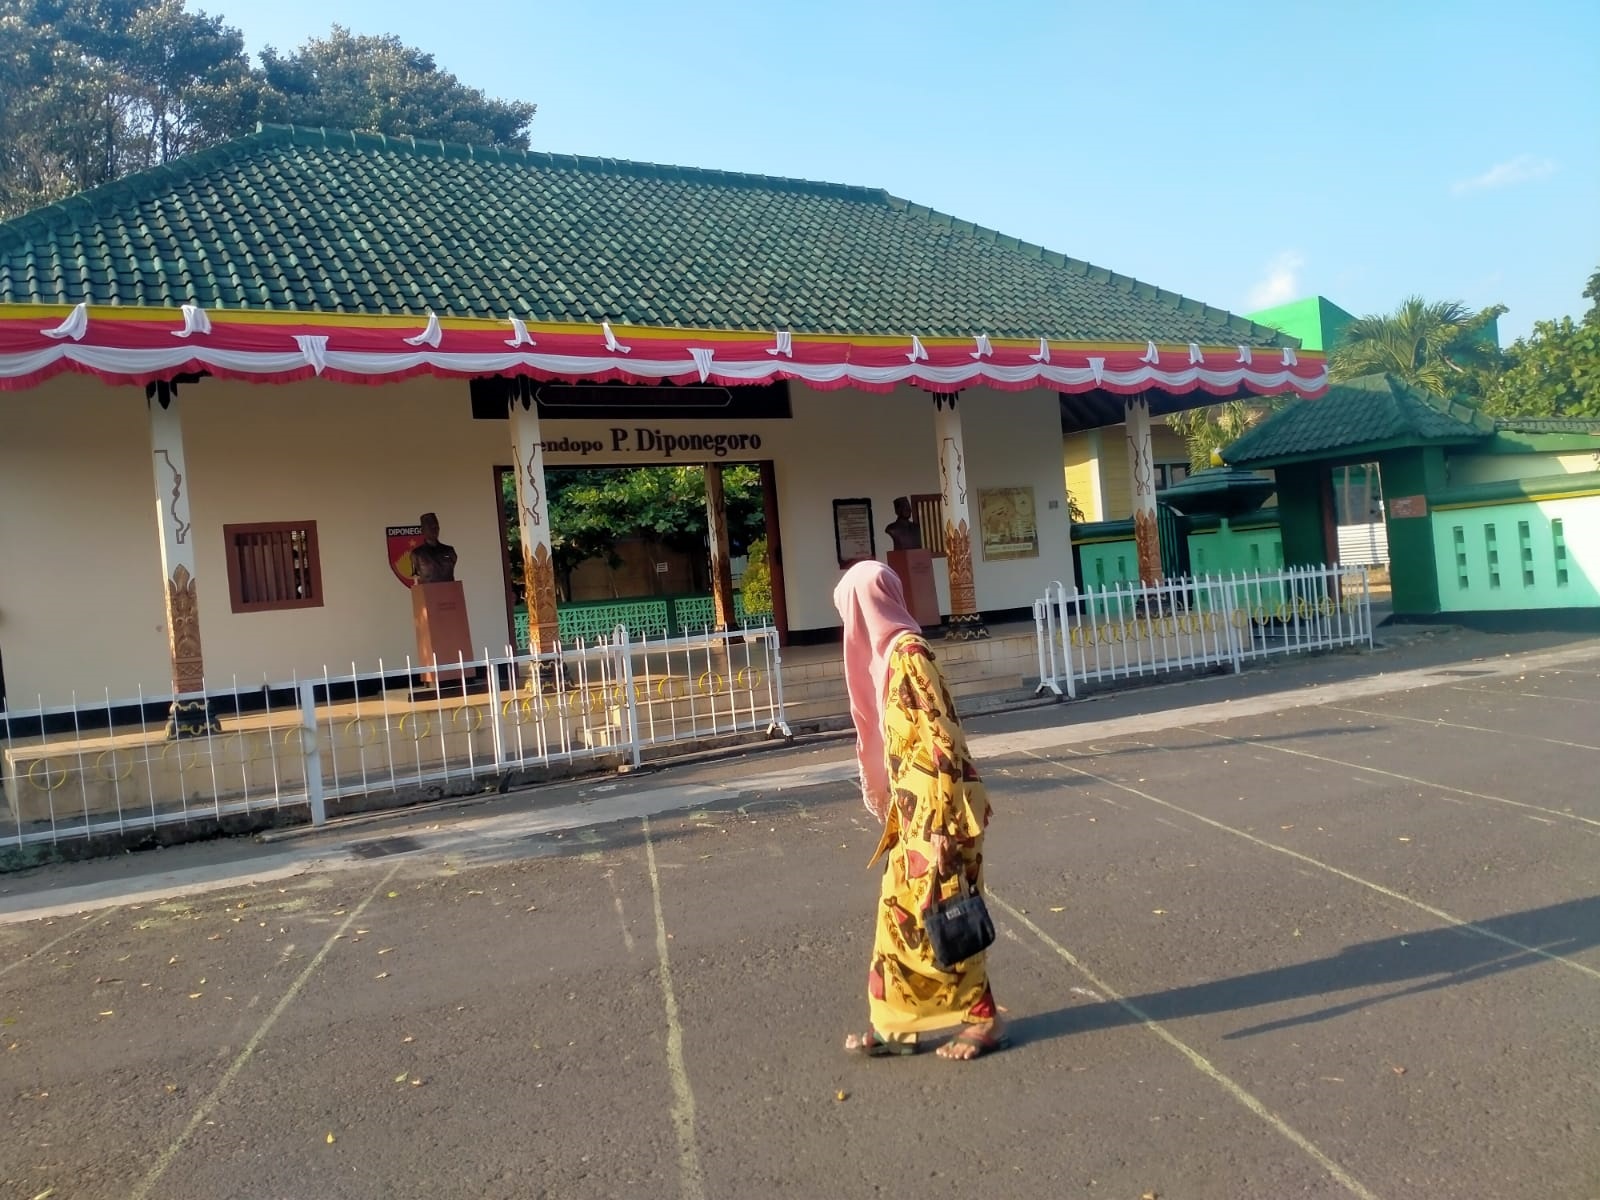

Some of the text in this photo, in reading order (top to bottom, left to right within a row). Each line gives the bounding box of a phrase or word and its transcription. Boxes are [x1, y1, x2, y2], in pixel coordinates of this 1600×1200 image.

[541, 427, 762, 457] endopo P. Diponegoro
